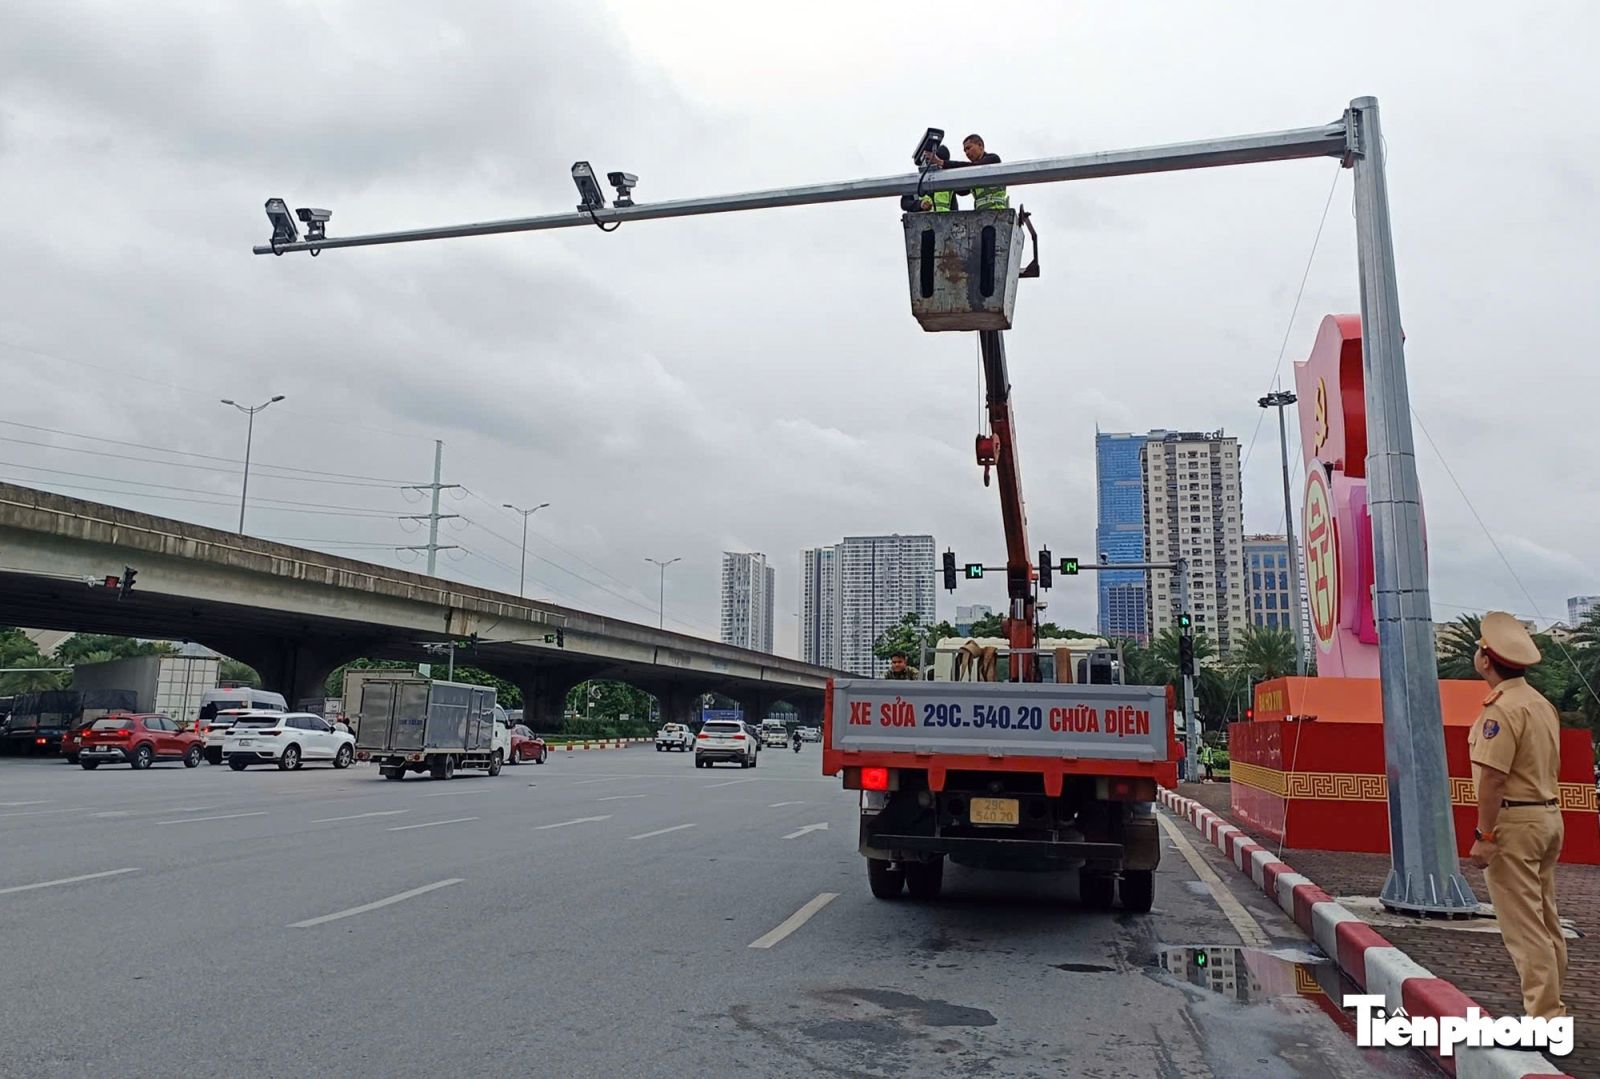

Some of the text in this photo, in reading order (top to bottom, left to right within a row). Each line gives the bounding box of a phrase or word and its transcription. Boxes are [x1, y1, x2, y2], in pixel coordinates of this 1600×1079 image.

[970, 566, 982, 577] 14
[849, 702, 872, 726] XE
[880, 696, 916, 727] SỬA
[1050, 704, 1100, 733] CHỮA
